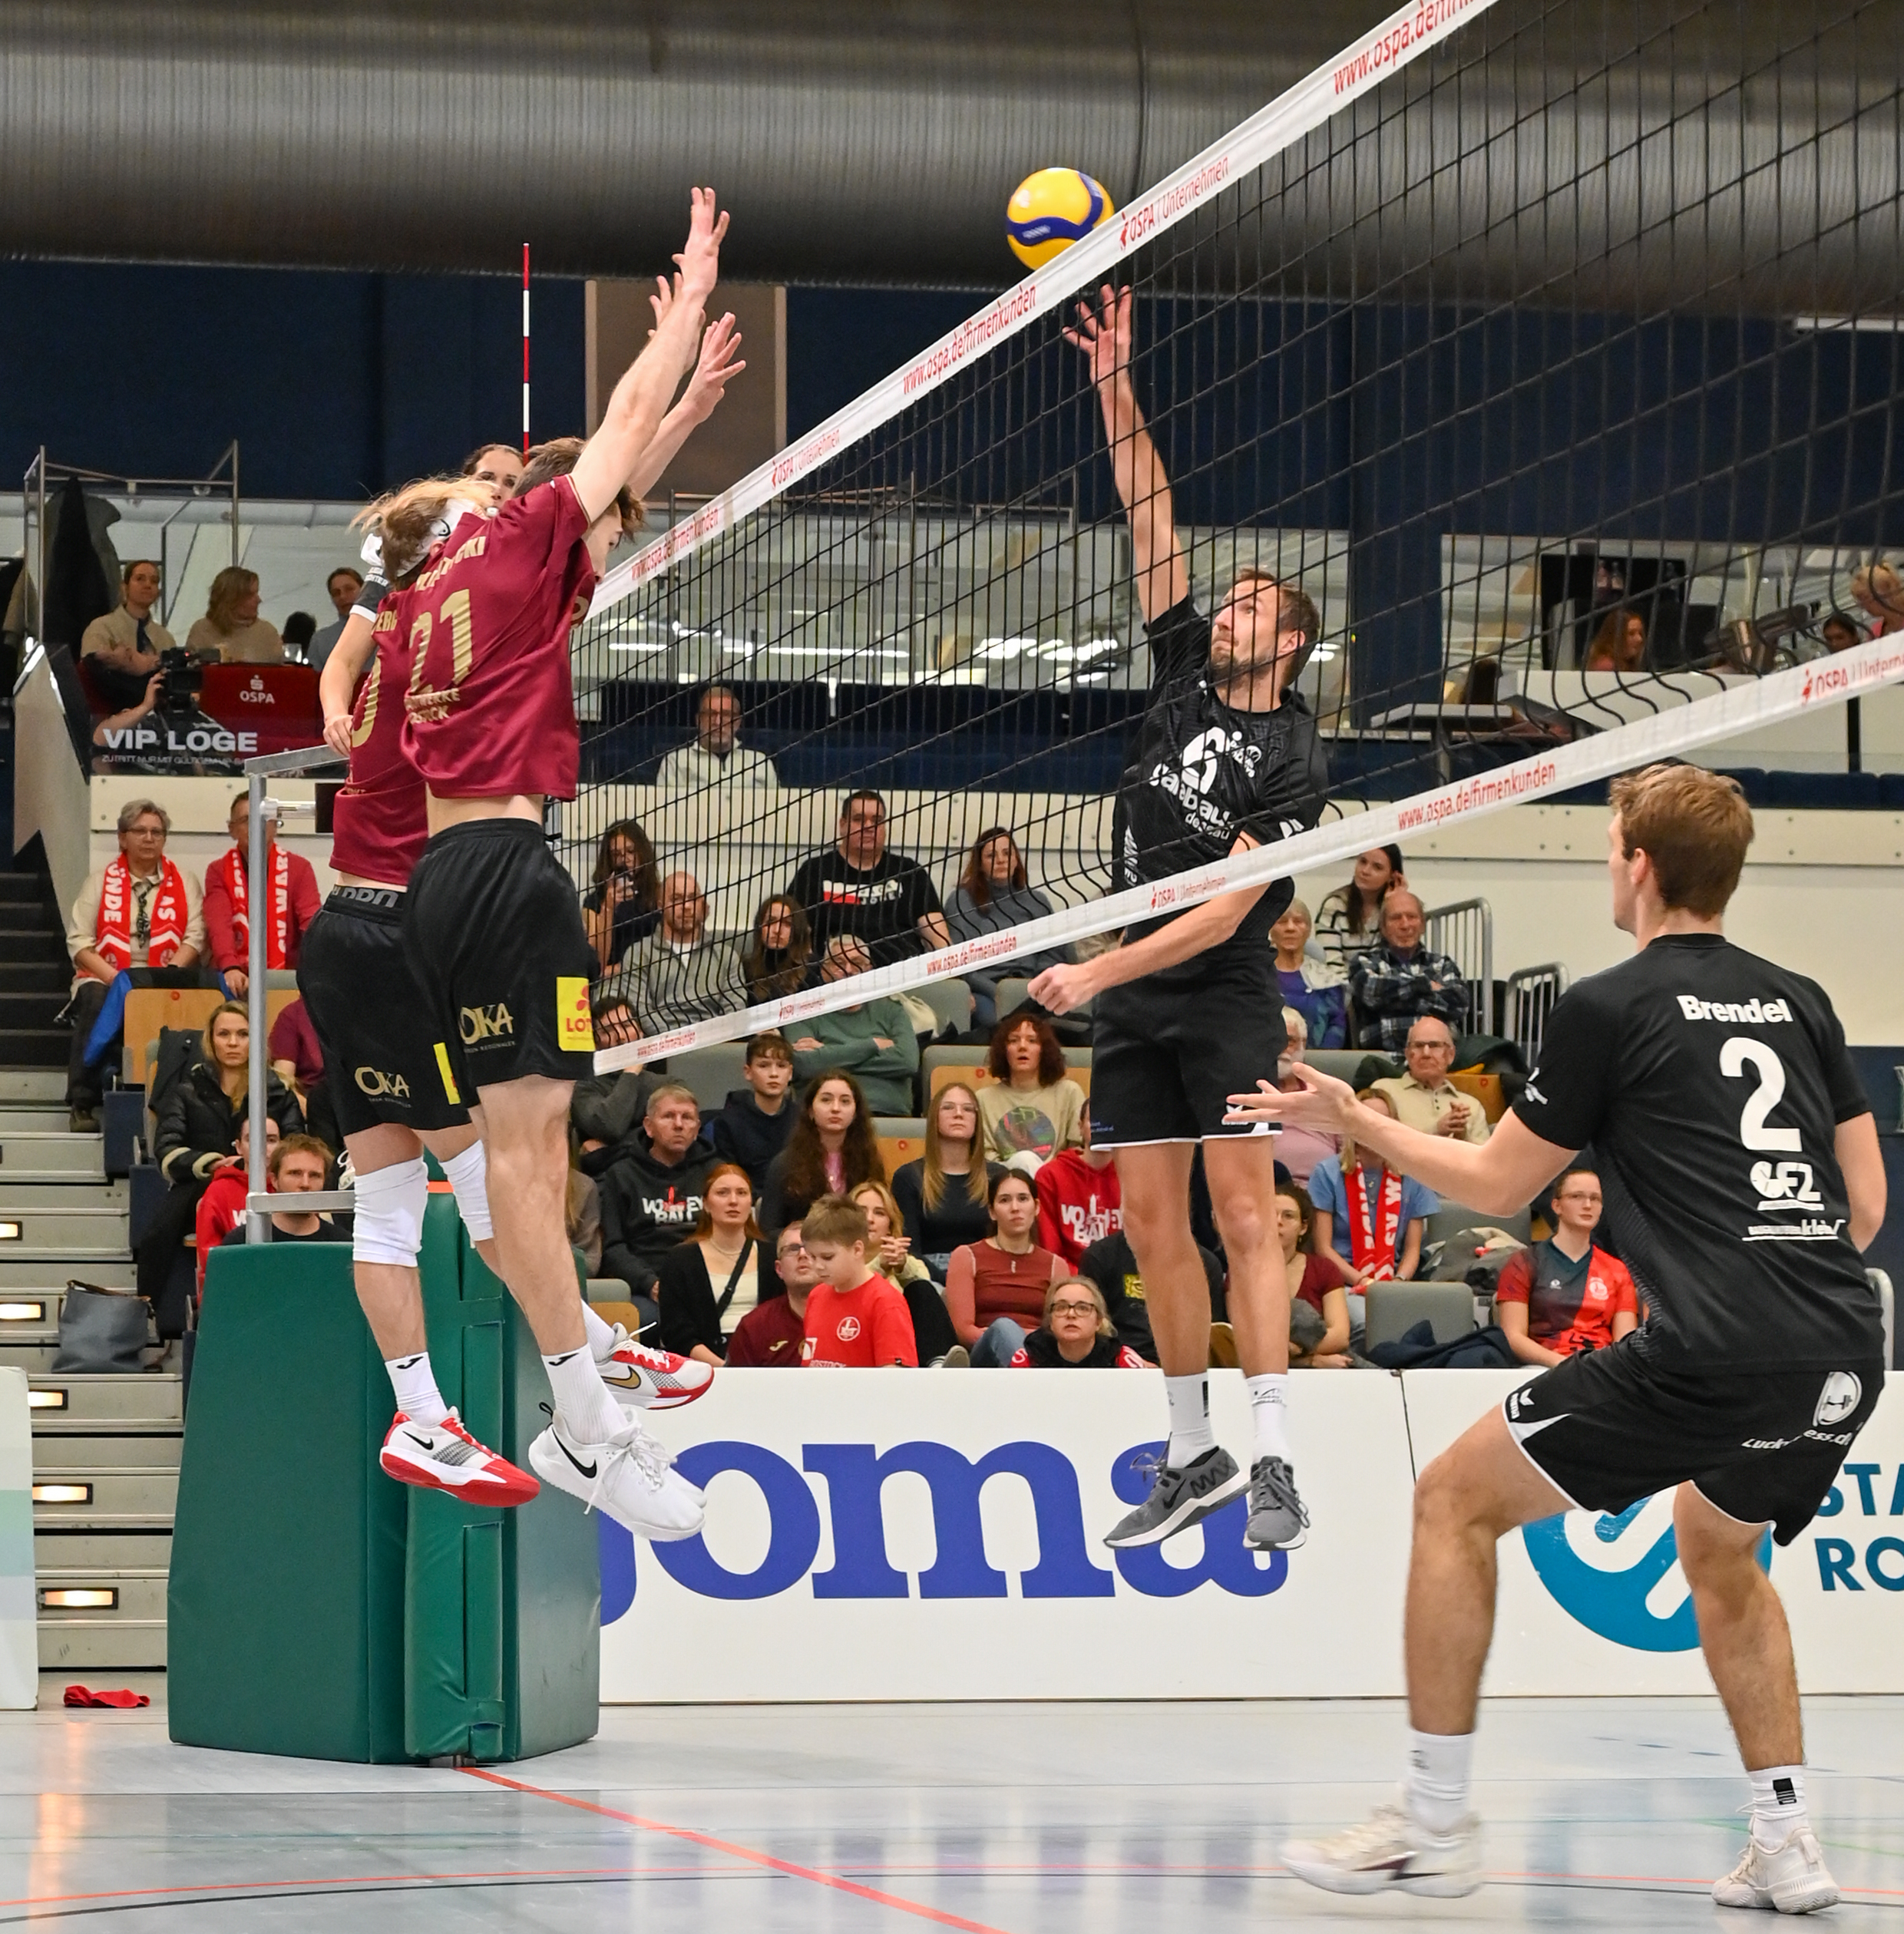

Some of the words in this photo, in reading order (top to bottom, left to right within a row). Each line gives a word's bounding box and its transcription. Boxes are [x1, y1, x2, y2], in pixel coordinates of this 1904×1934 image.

[1129, 203, 1155, 242] OSPA
[1162, 156, 1228, 219] Unternehmen
[903, 284, 1036, 395] www.ospa.de/firmenkunden
[409, 589, 472, 693] 21
[240, 690, 275, 704] OSPA
[103, 728, 157, 750] VIP
[167, 730, 258, 753] LOGE
[1397, 760, 1556, 831] www.ospa.de/firmenkunden
[104, 861, 126, 924] ÜNDE
[460, 1003, 514, 1045] OKA
[567, 1017, 592, 1033] LOT
[1676, 995, 1794, 1023] Brendel
[354, 1066, 410, 1098] OKA
[1720, 1036, 1803, 1152] 2
[1814, 1536, 1904, 1592] RO
